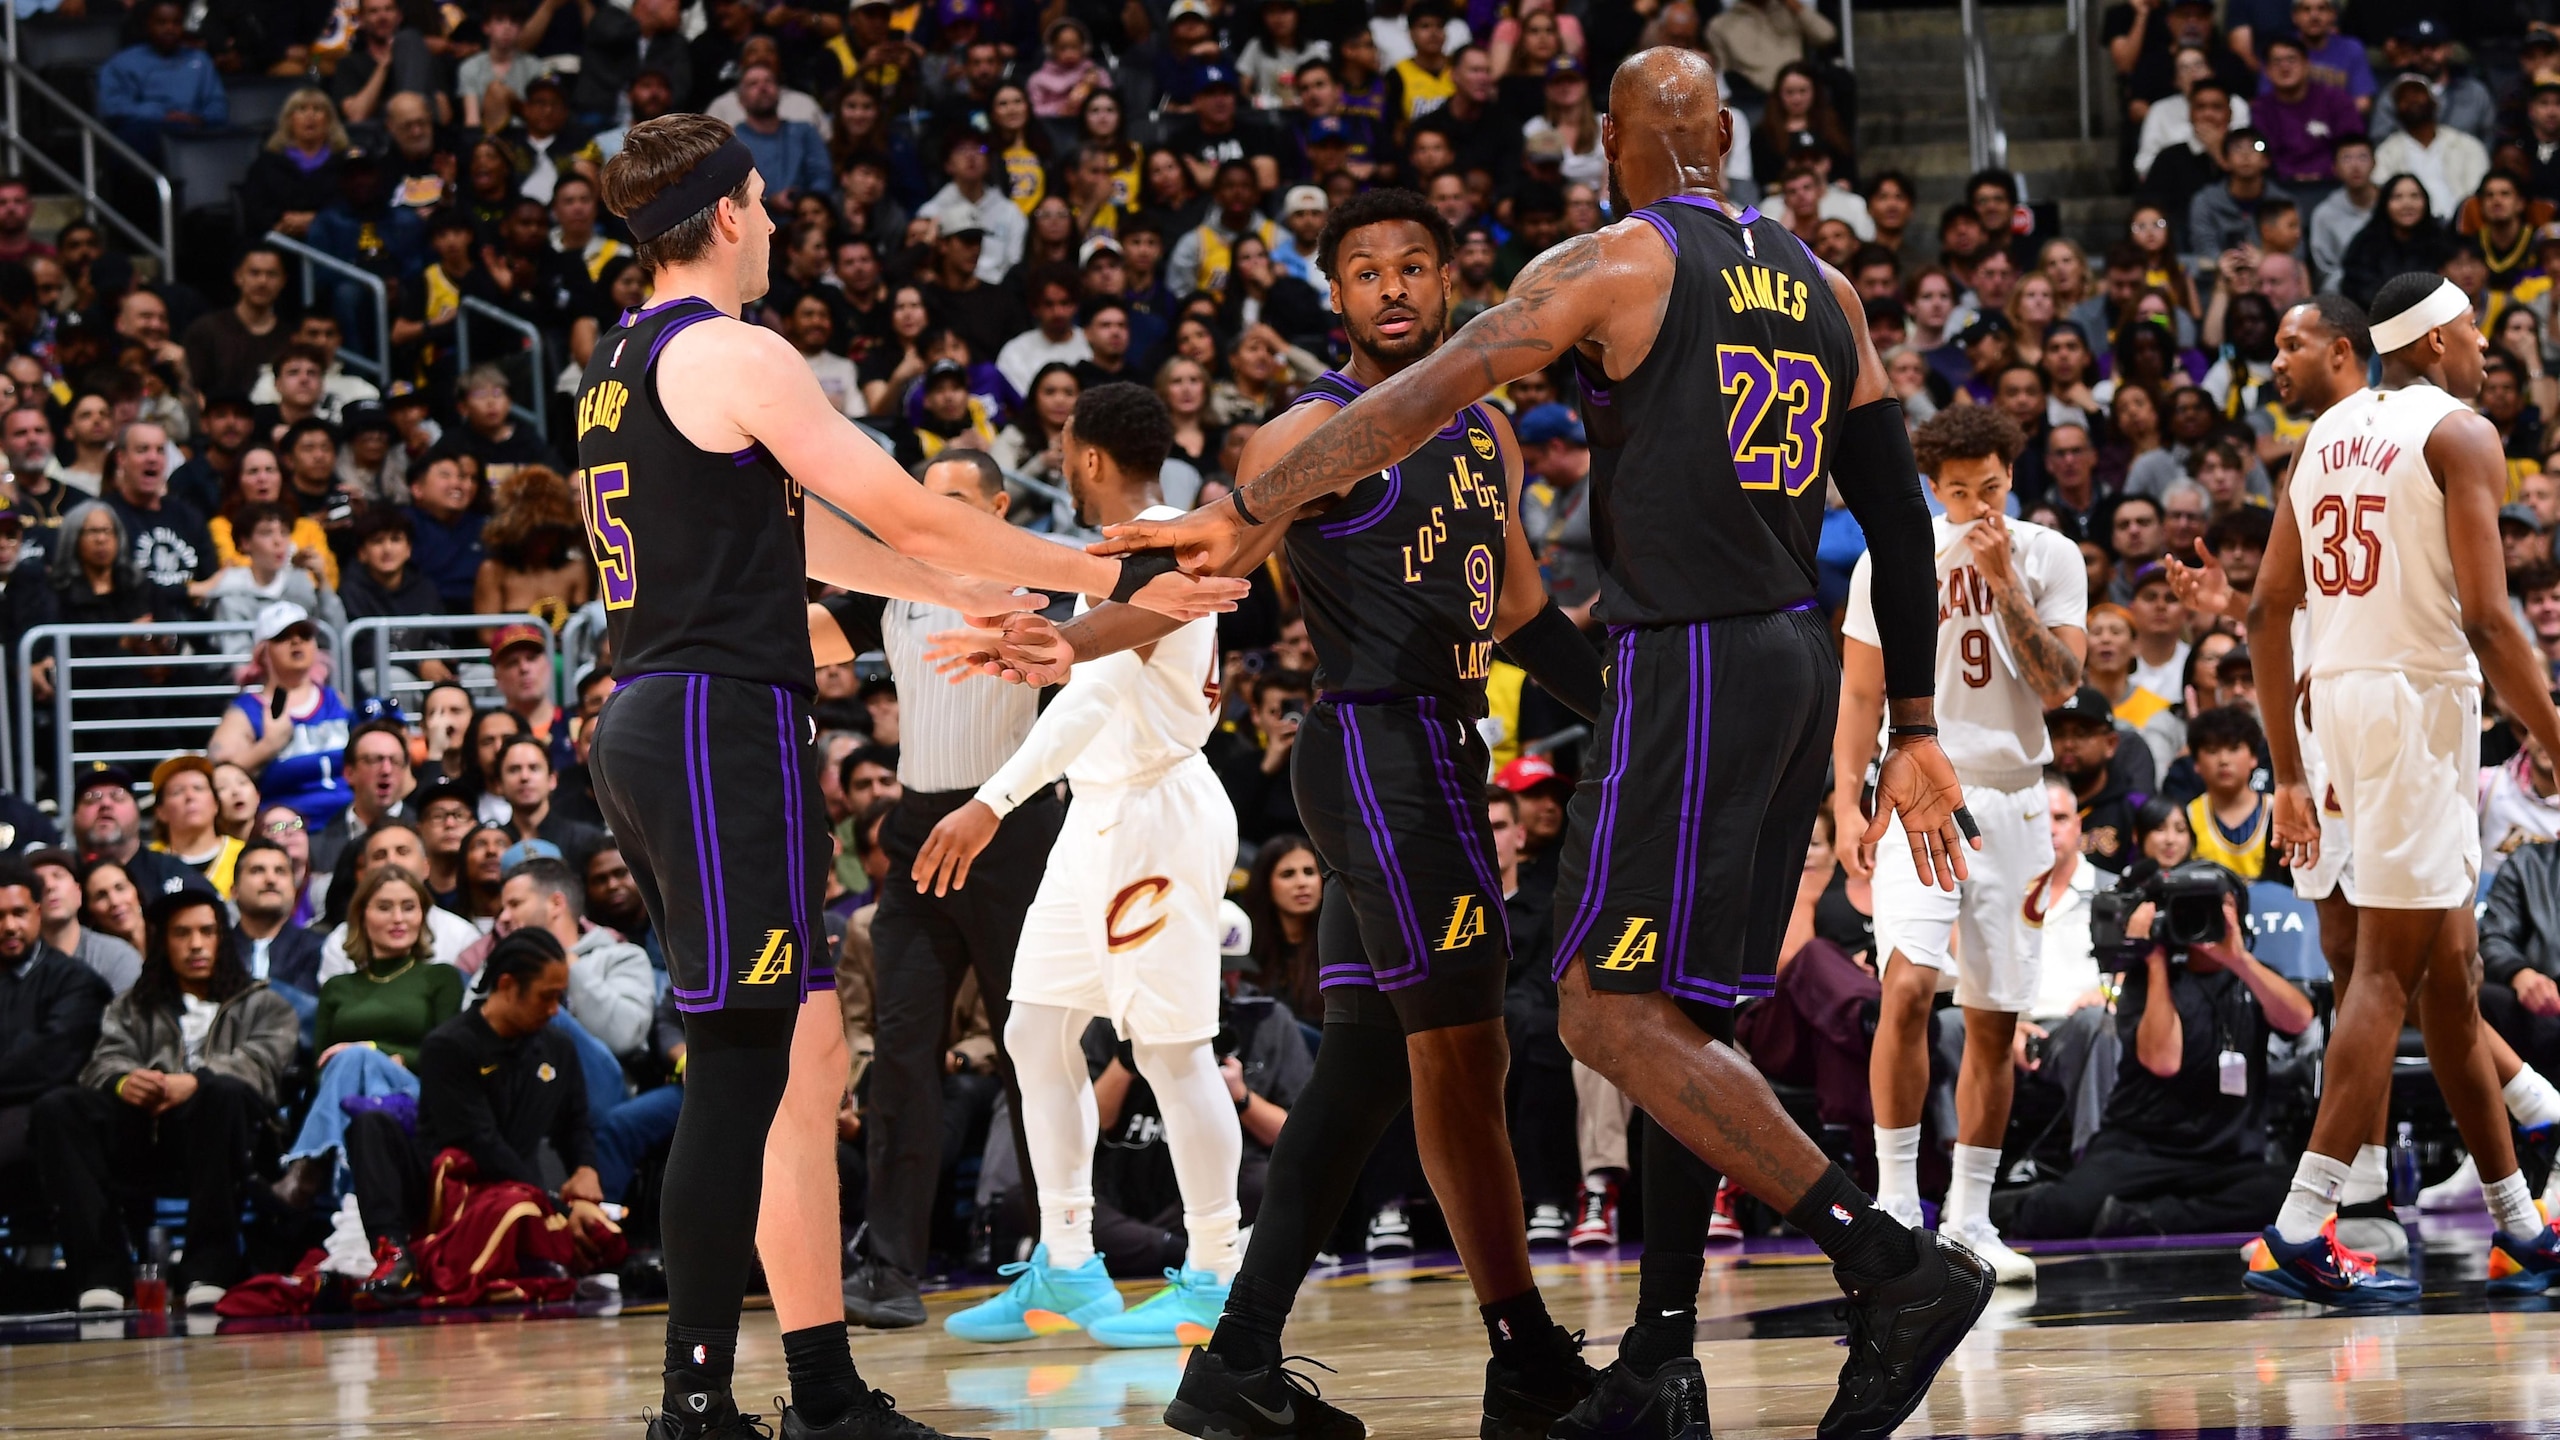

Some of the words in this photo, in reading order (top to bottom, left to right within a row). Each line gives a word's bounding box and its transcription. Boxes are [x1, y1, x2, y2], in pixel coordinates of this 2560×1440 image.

[1720, 264, 1808, 321] JAMES
[1716, 343, 1831, 497] 23
[2317, 435, 2401, 476] TOMLIN
[1402, 506, 1446, 585] LOS
[2311, 494, 2387, 597] 35
[1464, 543, 1495, 631] 9
[1961, 629, 1992, 689] 9
[1432, 894, 1488, 952] LA
[1595, 917, 1659, 972] LA
[737, 928, 793, 985] LA
